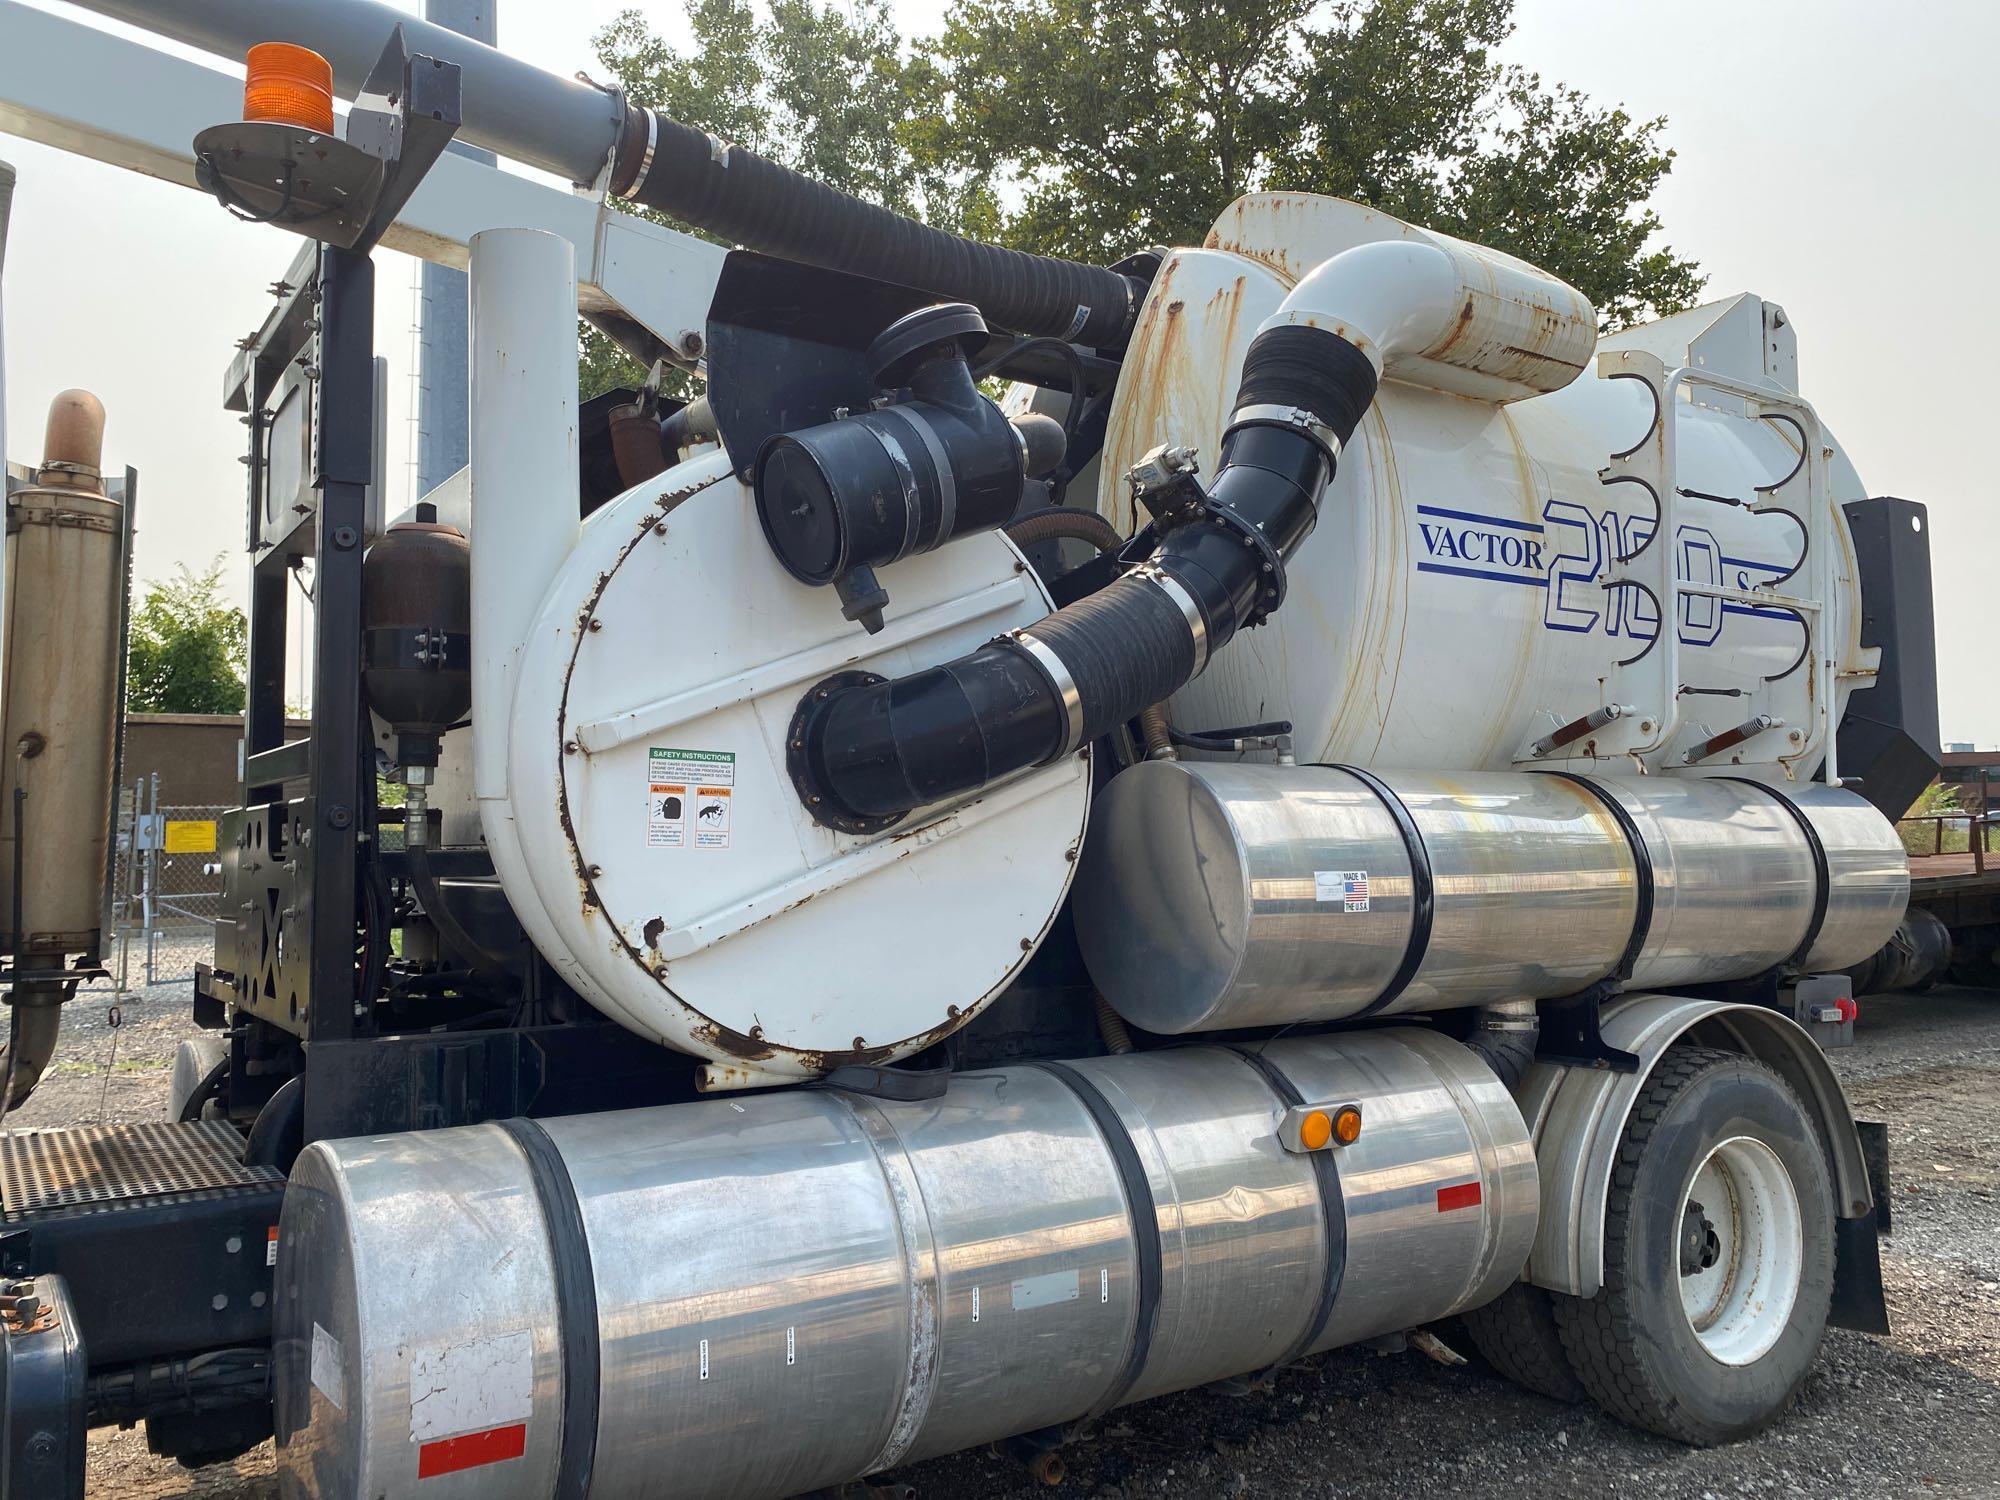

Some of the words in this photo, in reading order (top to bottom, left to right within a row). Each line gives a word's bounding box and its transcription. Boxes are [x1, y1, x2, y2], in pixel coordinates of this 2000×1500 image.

[1418, 522, 1545, 571] VACTOR
[653, 750, 681, 758] SAFETY
[681, 752, 731, 762] INSTRUCTIONS
[1343, 872, 1359, 880] MADE
[1360, 872, 1367, 880] IN
[1345, 902, 1355, 911] THE
